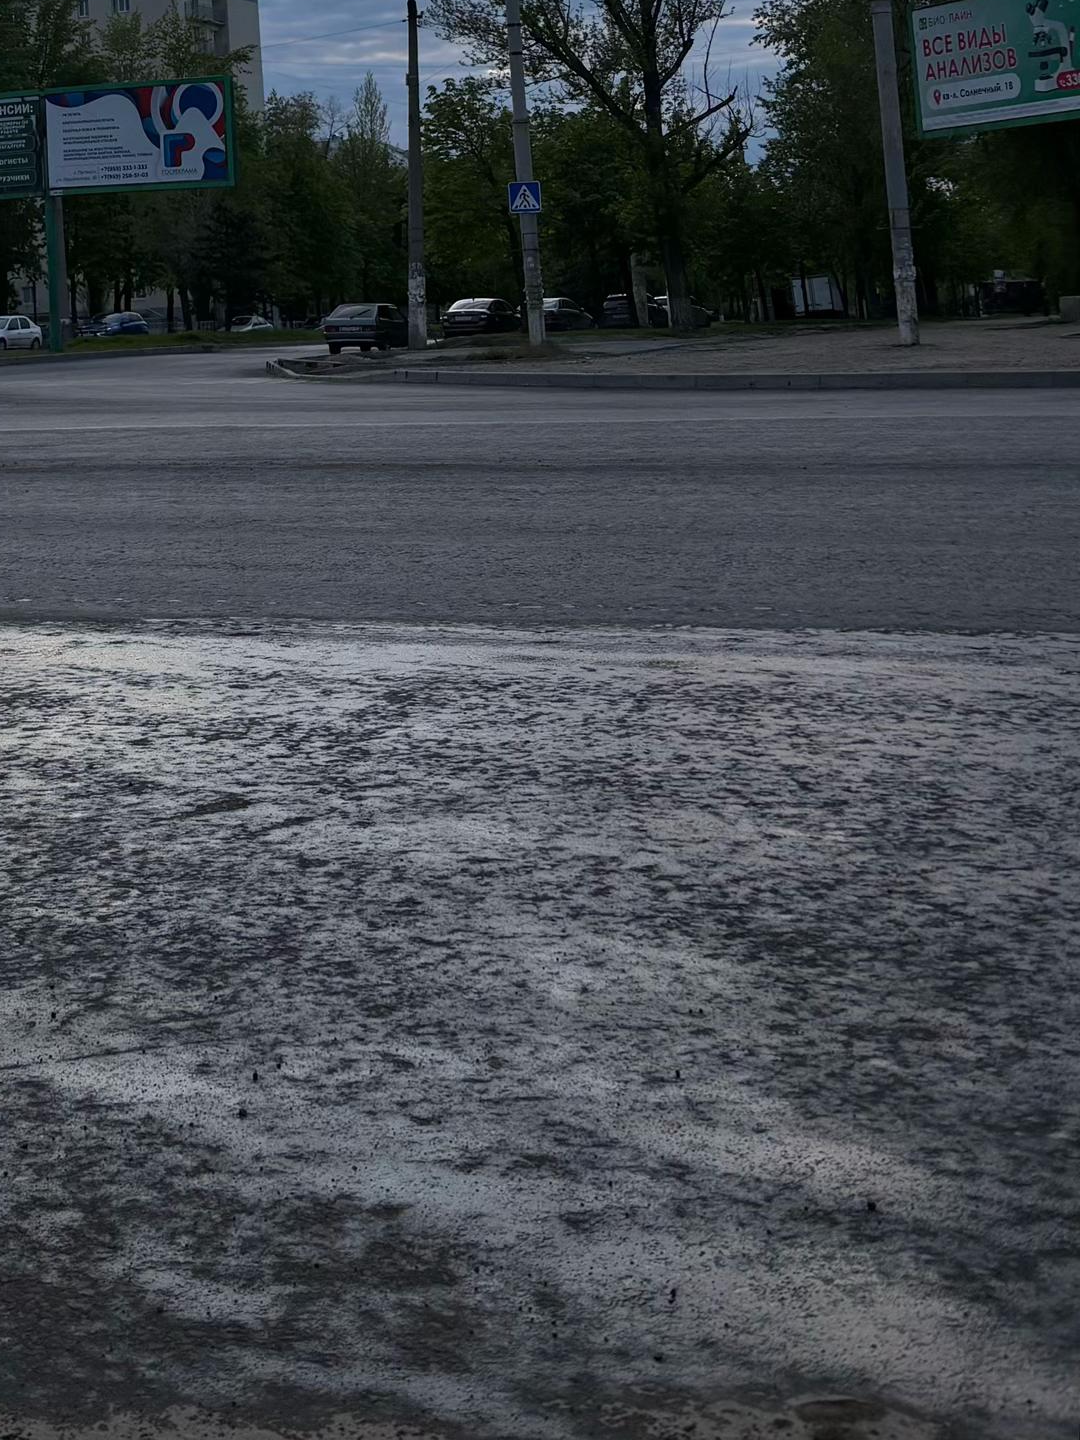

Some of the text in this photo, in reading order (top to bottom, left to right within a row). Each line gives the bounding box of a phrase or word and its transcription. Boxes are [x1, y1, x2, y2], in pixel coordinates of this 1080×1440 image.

[923, 23, 1006, 57] ВСЕ ВИДЫ
[926, 48, 1017, 81] АНАЛИЗОВ
[1066, 72, 1080, 87] 33
